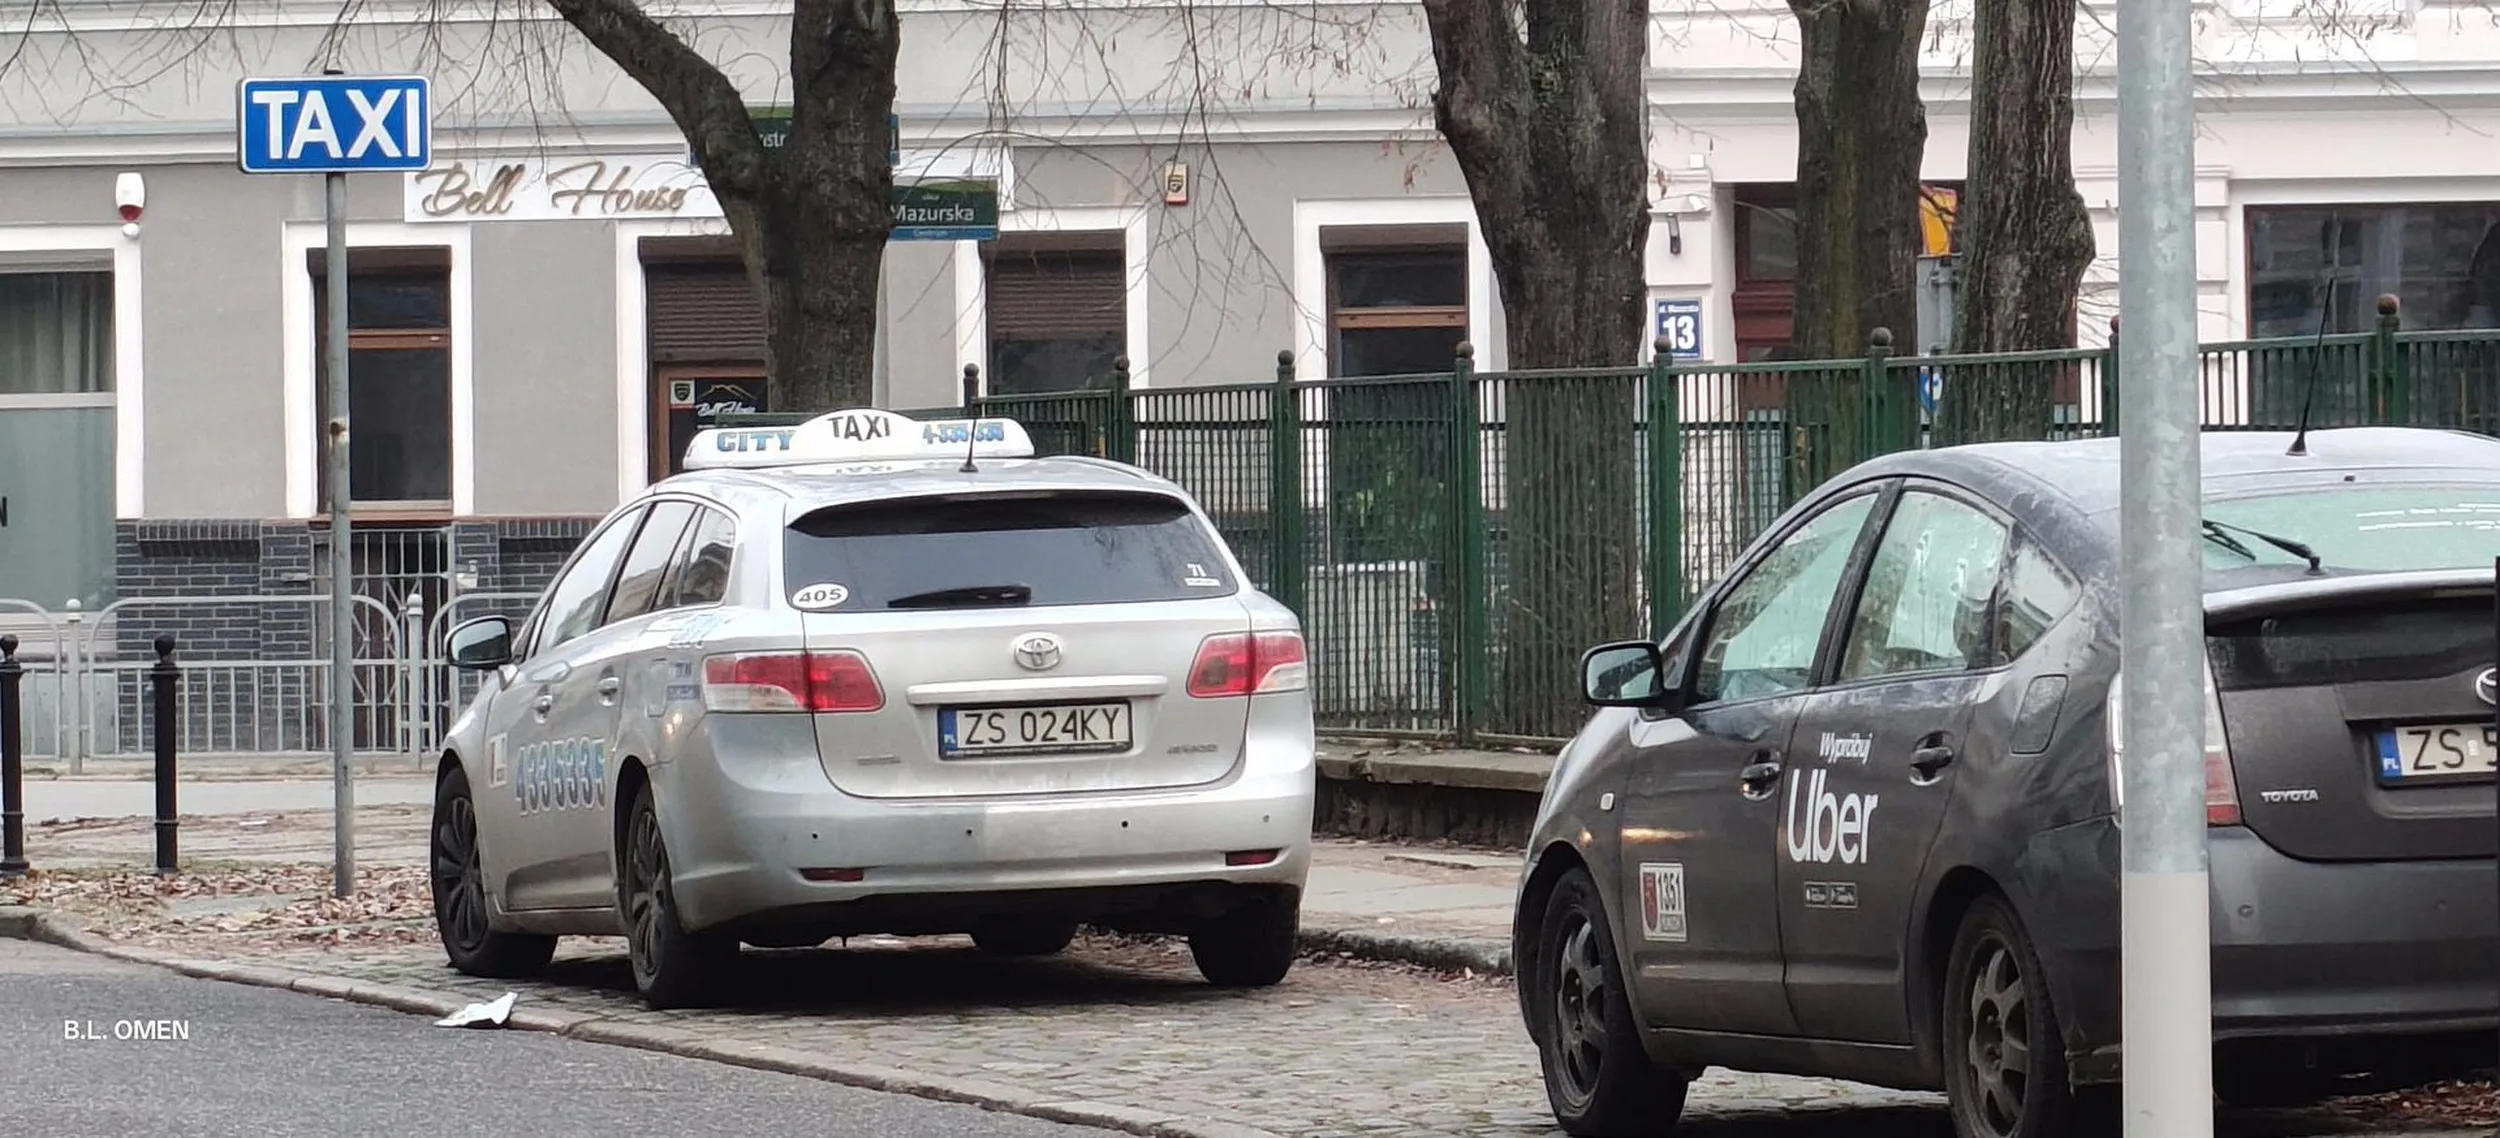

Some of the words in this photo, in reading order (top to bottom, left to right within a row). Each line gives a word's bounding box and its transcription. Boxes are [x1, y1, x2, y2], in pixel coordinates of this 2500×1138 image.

[252, 88, 421, 160] TAXI
[414, 161, 525, 216] Bell
[546, 161, 688, 214] House
[890, 203, 975, 222] Mazurska
[1662, 315, 1696, 350] 13
[717, 430, 796, 453] CITY
[828, 415, 891, 442] TAXI
[799, 588, 842, 603] 405
[964, 713, 1006, 745] ZS
[1019, 707, 1120, 743] 024KY
[2407, 728, 2465, 770] ZS
[2261, 789, 2319, 803] TOYOTA
[1787, 768, 1879, 864] Uber
[1658, 872, 1681, 911] 1351
